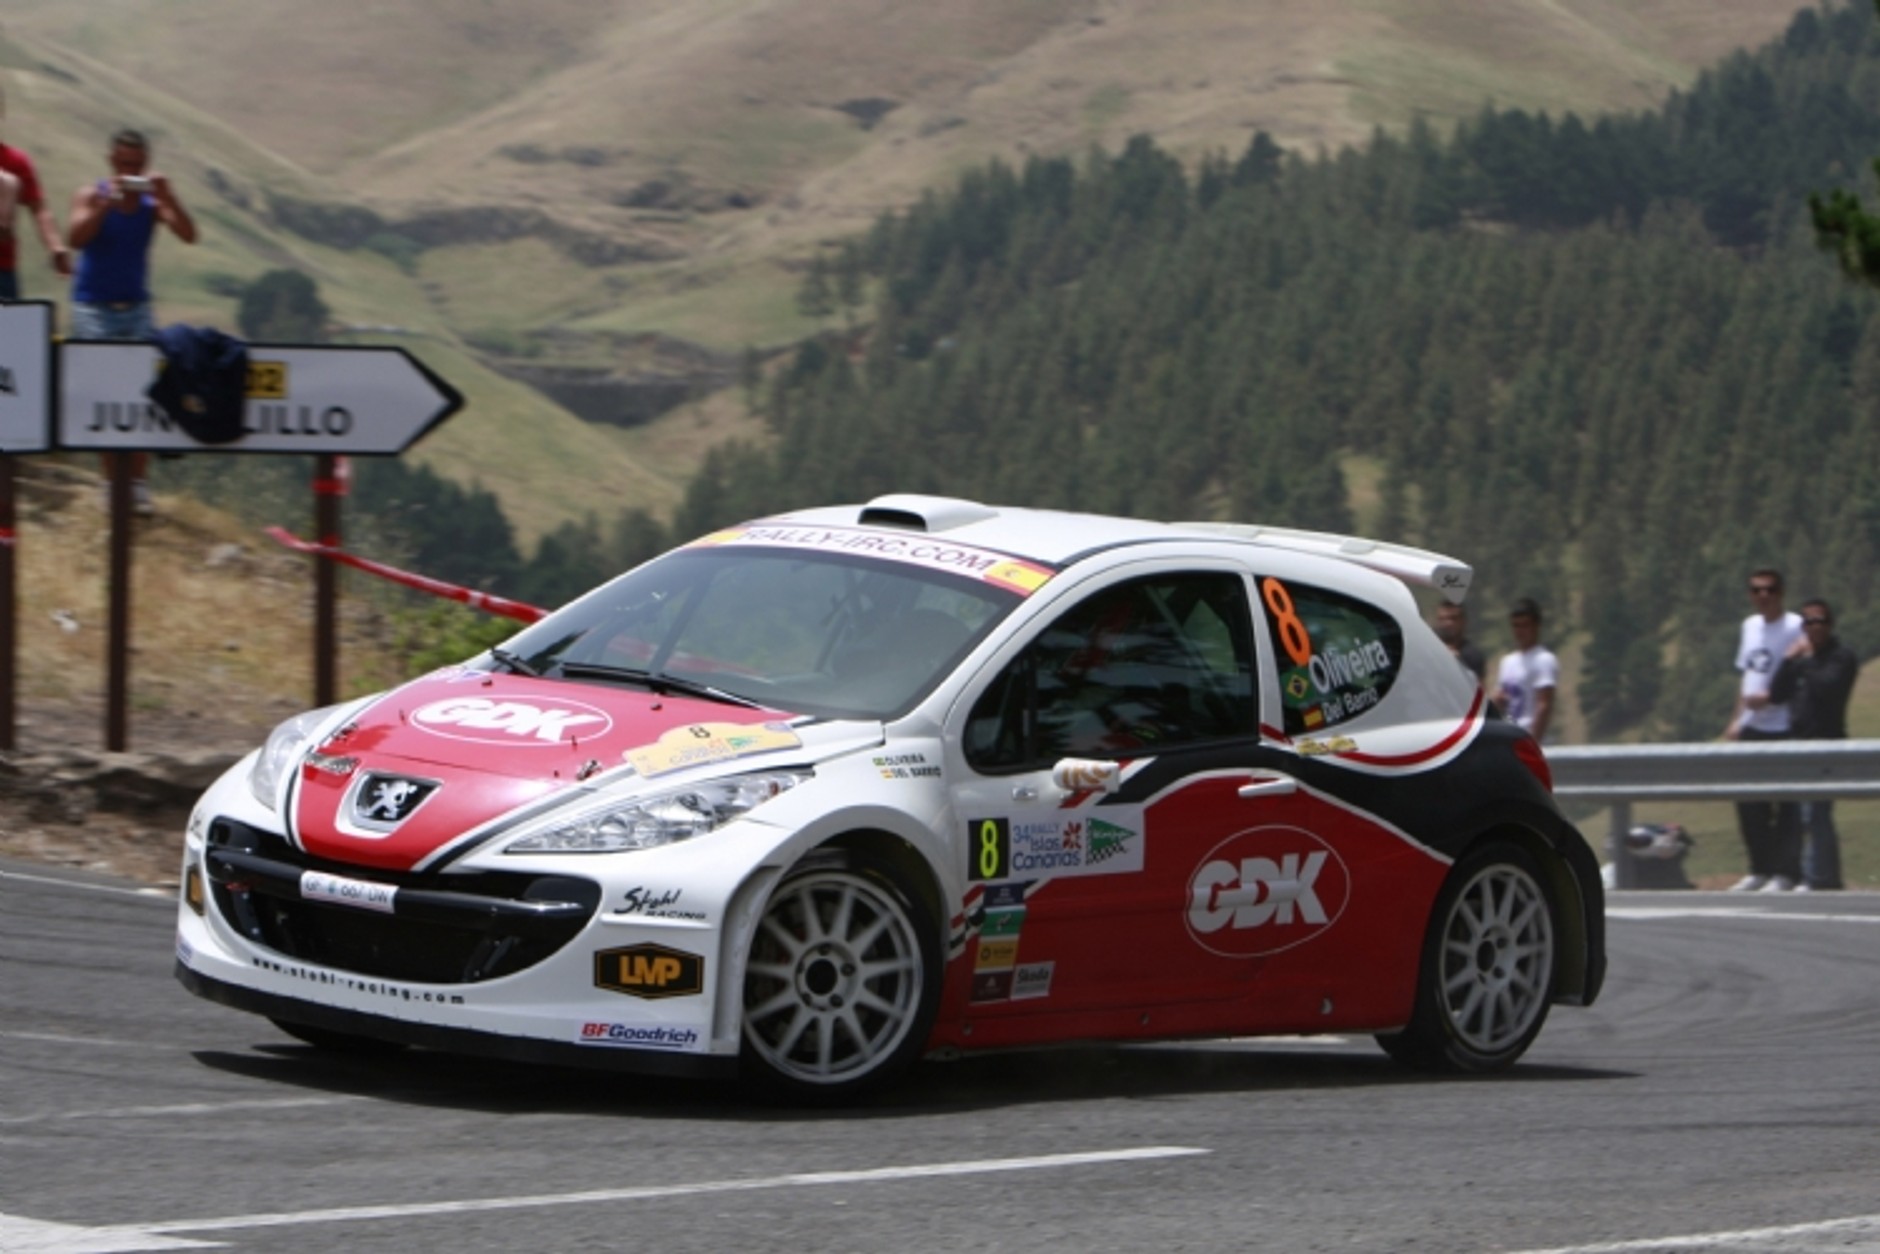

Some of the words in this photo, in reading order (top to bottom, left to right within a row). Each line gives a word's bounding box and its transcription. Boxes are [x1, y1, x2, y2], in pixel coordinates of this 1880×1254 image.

[1263, 577, 1312, 667] 8
[1309, 638, 1390, 694] Oliveira
[416, 697, 604, 743] GDK
[979, 819, 999, 878] 8
[1013, 825, 1030, 844] 34
[1030, 837, 1061, 852] Islas
[1188, 851, 1329, 934] GDK
[644, 910, 706, 919] RACING
[620, 955, 681, 986] LMP
[581, 1023, 697, 1042] BFGoodrich
